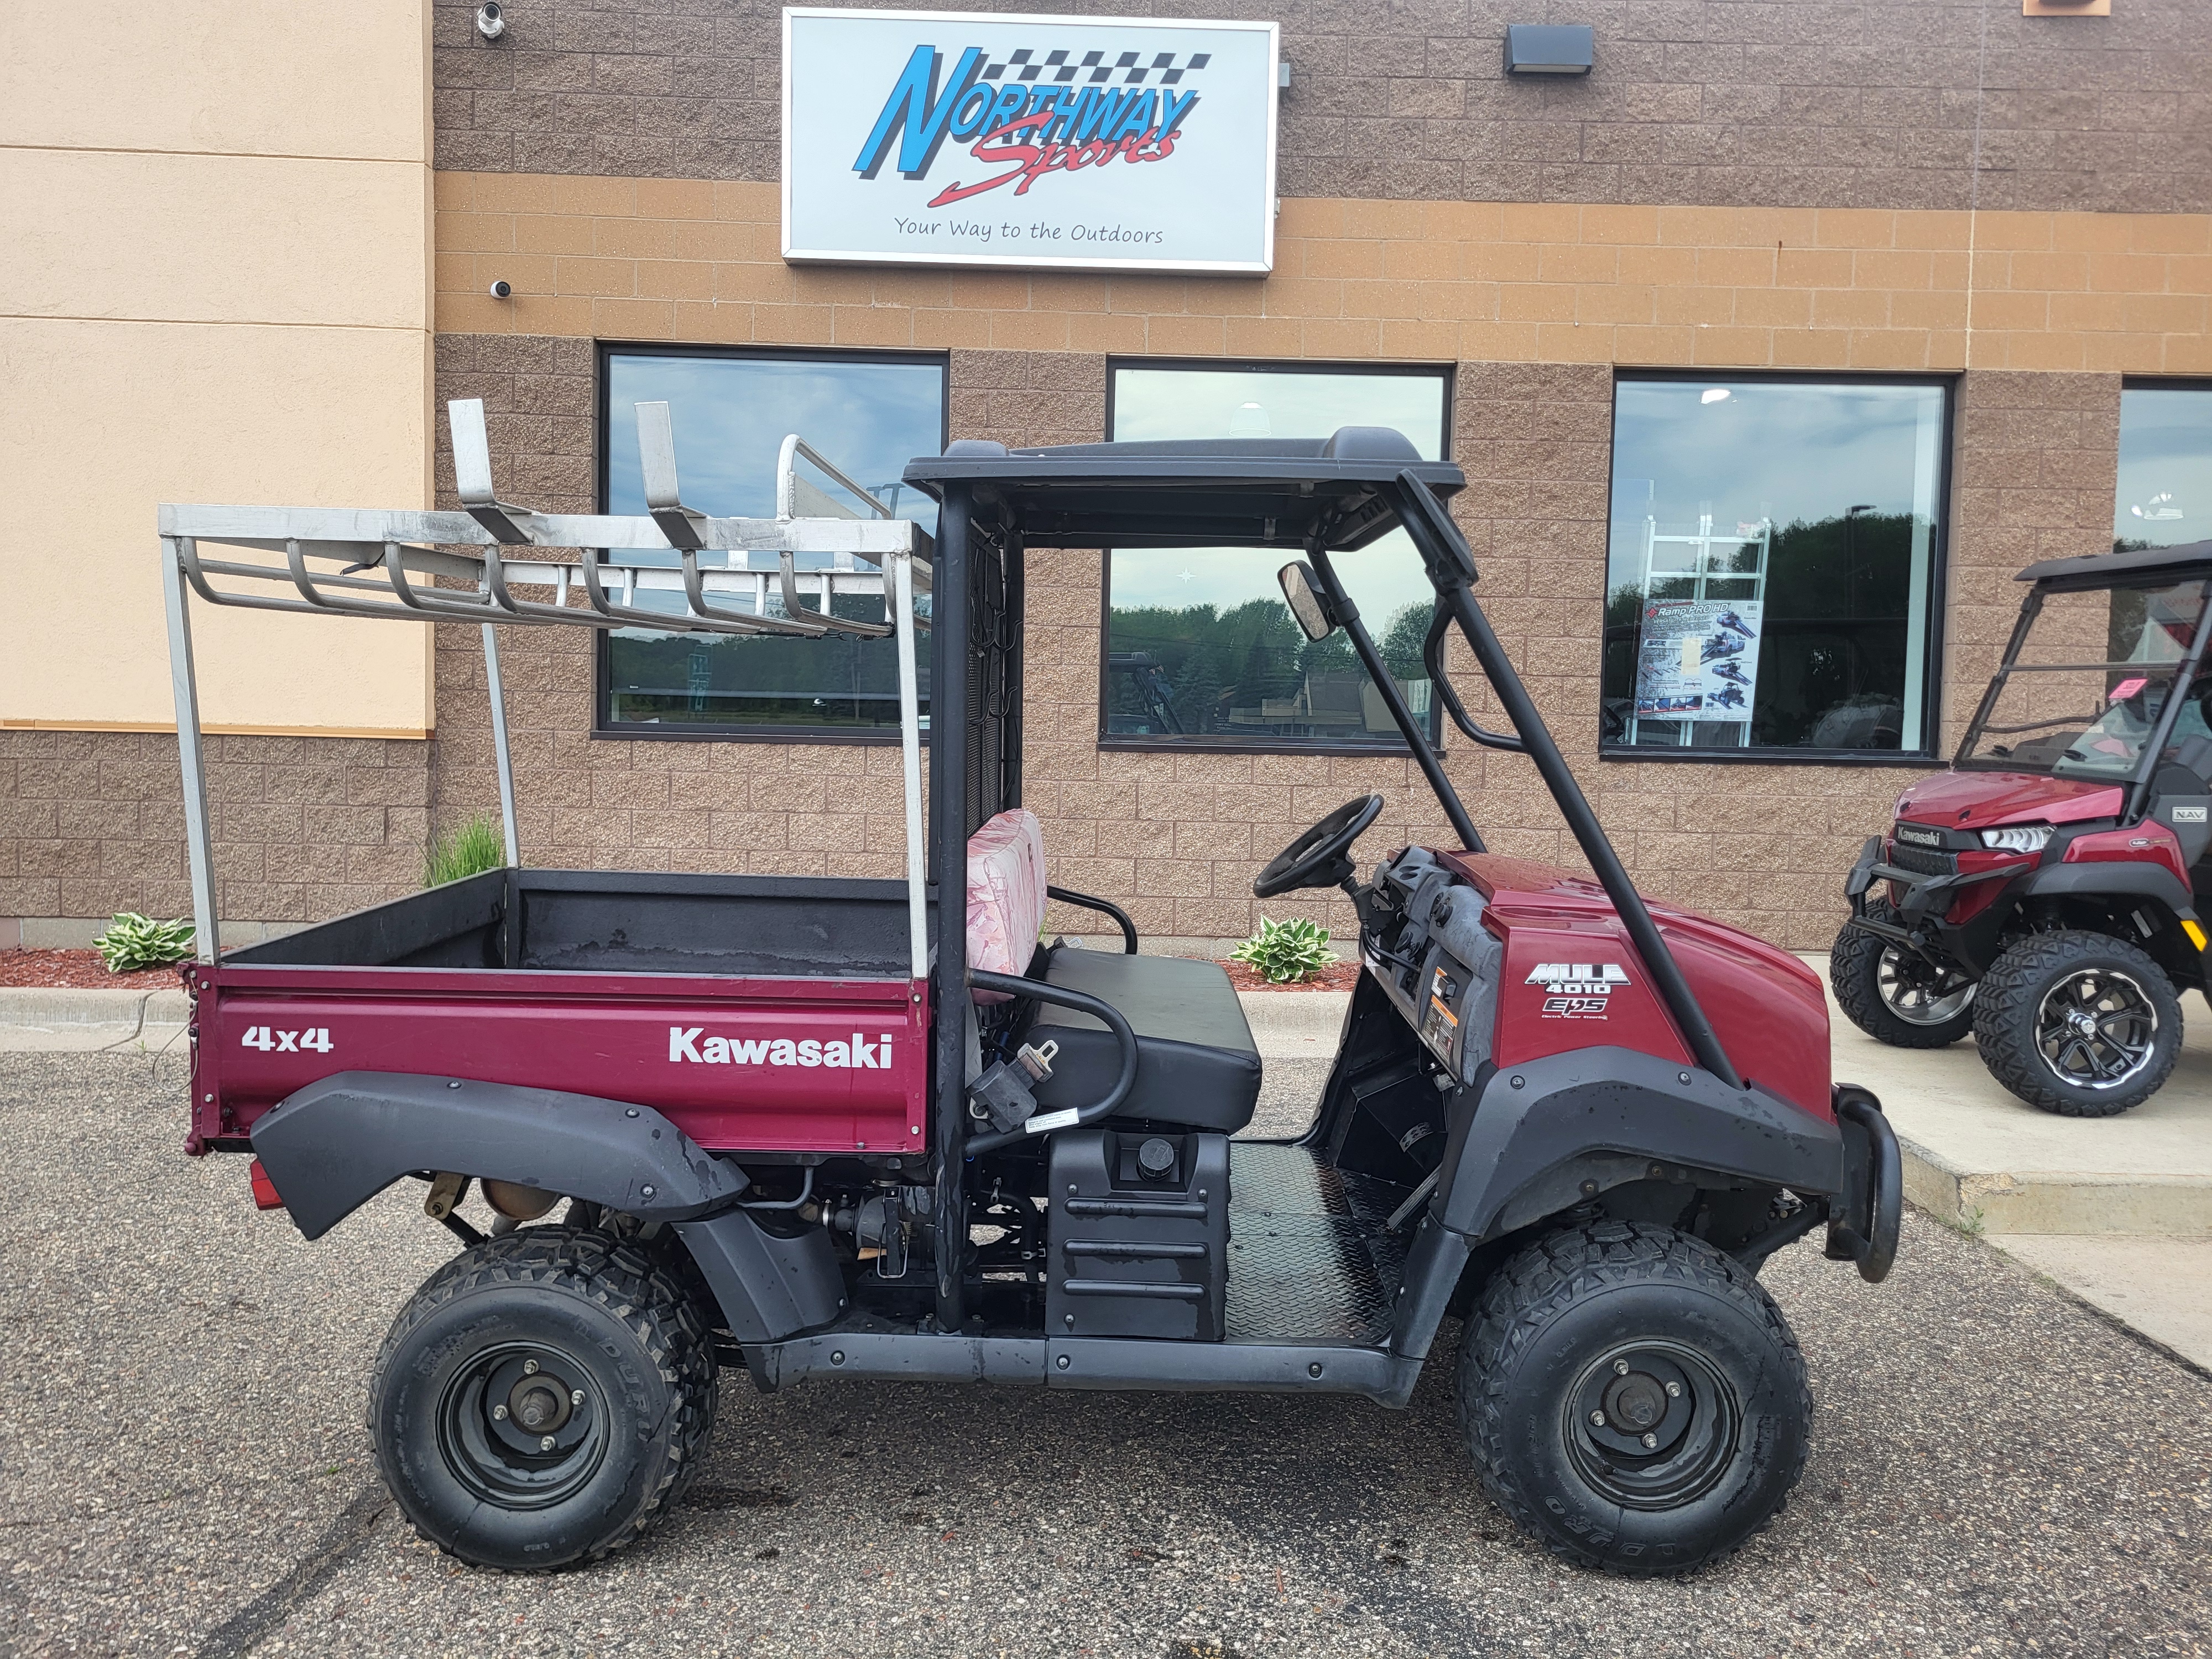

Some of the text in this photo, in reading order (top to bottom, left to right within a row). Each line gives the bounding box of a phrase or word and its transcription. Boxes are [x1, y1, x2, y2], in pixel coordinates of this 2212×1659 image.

[927, 111, 1181, 208] Sports
[894, 217, 1163, 243] Your Way to the Outdoors
[1658, 603, 1729, 617] Ramp PRO HD
[1898, 826, 1939, 846] Kawasaki
[1524, 963, 1631, 985] MULE
[1546, 984, 1611, 994] 4010
[242, 1026, 333, 1053] 4x4
[669, 1027, 892, 1069] Kawasaki
[1545, 1496, 1647, 1556] DURO
